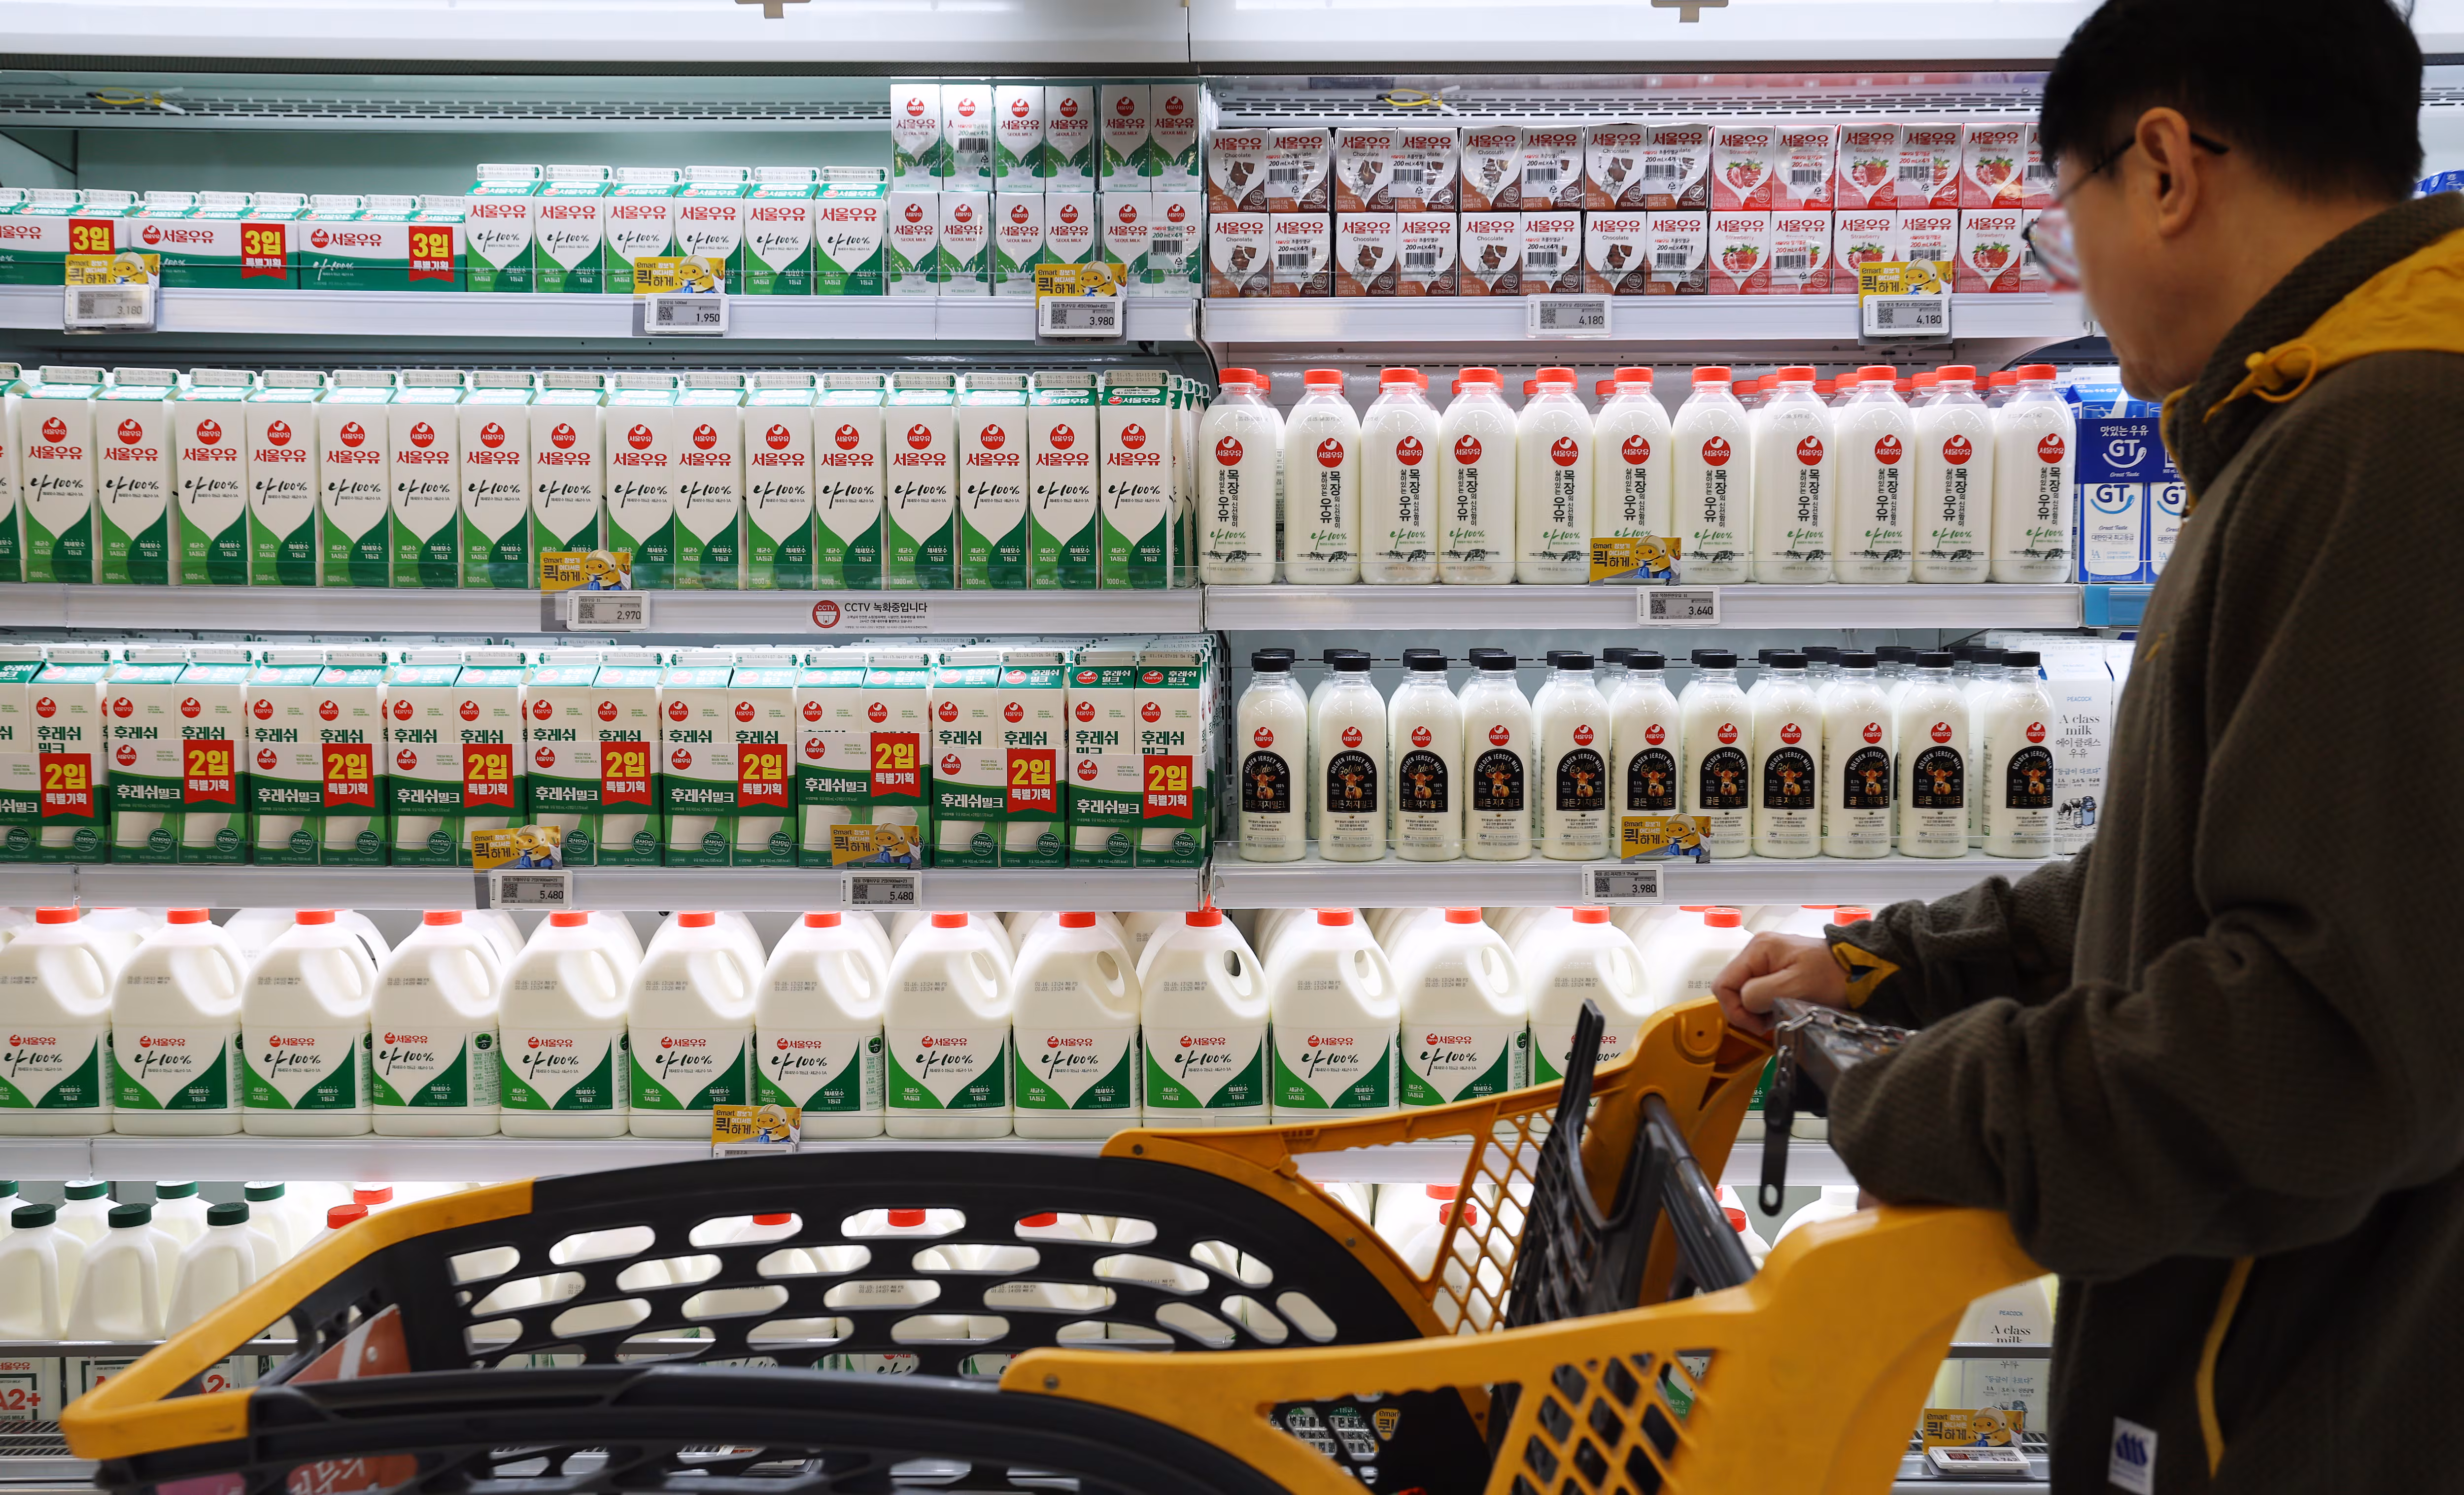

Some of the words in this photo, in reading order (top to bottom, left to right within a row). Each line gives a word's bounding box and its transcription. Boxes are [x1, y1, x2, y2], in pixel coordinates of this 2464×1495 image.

[471, 205, 526, 218] 서울우유
[541, 206, 595, 219] 서울우유
[611, 206, 666, 219] 서울우유
[681, 207, 736, 220] 서울우유
[751, 208, 805, 221] 서울우유
[821, 208, 876, 221] 서울우유
[1215, 223, 1263, 234] 서울우유
[1342, 222, 1391, 234] 서울우유
[1467, 221, 1514, 233] 서울우유
[1592, 221, 1640, 232] 서울우유
[1716, 221, 1763, 232] 서울우유
[1841, 220, 1889, 231] 서울우유
[1902, 219, 1951, 231] 서울우유
[74, 227, 109, 250] 3입
[163, 230, 213, 243] 서울우유
[245, 231, 281, 254] 3입
[331, 234, 381, 246] 서울우유
[413, 234, 448, 257] 3입
[29, 446, 83, 459] 서울우유
[104, 447, 158, 461] 서울우유
[2109, 440, 2140, 457] GT
[327, 450, 379, 463] 서울우유
[467, 451, 519, 464] 서울우유
[679, 453, 730, 466] 서울우유
[821, 453, 873, 466] 서울우유
[1108, 452, 1160, 465] 서울우유
[2097, 485, 2129, 502] GT
[845, 603, 870, 612] CCTV
[873, 603, 927, 612] 녹화중입니다
[2059, 715, 2068, 723] A
[2073, 714, 2099, 723] class
[2066, 725, 2092, 735] milk
[1142, 731, 1184, 745] 후레쉬
[2069, 749, 2088, 758] 우유
[189, 750, 228, 776] 2입
[468, 754, 507, 779] 2입
[744, 754, 782, 779] 2입
[1478, 755, 1492, 772] GOLDEN
[1511, 760, 1520, 773] MILK
[45, 764, 86, 788] 2입
[1149, 766, 1187, 790] 2입
[189, 780, 229, 791] 특별기획
[743, 783, 782, 794] 특별기획
[46, 793, 86, 804] 특별기획
[1148, 795, 1186, 806] 특별기획
[1991, 1325, 2000, 1334] A
[2004, 1325, 2030, 1335] class
